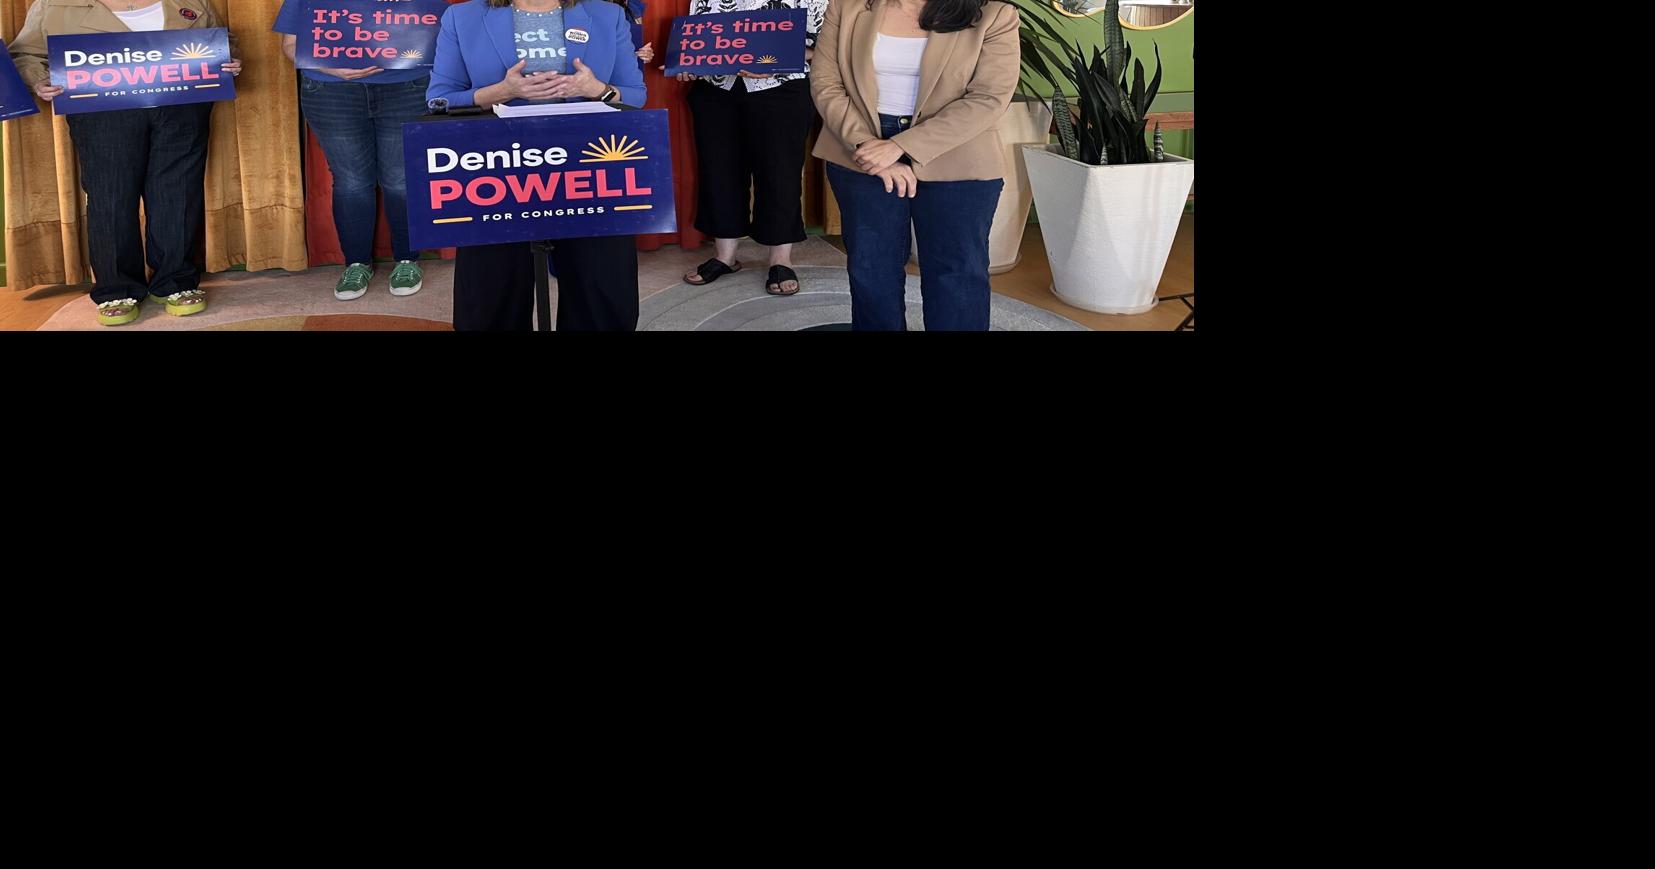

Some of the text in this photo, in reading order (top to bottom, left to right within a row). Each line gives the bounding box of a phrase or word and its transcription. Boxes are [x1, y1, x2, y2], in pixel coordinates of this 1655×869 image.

[313, 9, 438, 25] It's time
[312, 26, 390, 41] to be
[682, 18, 794, 36] It's time
[313, 43, 398, 58] brave
[680, 36, 747, 51] to be
[64, 47, 163, 67] Denise
[680, 53, 754, 66] brave
[66, 62, 219, 90] POWELL
[131, 85, 189, 95] CONGRESS
[426, 142, 568, 174] Denise
[429, 167, 652, 210] POWELL
[482, 206, 605, 222] FOR CONGRESS
